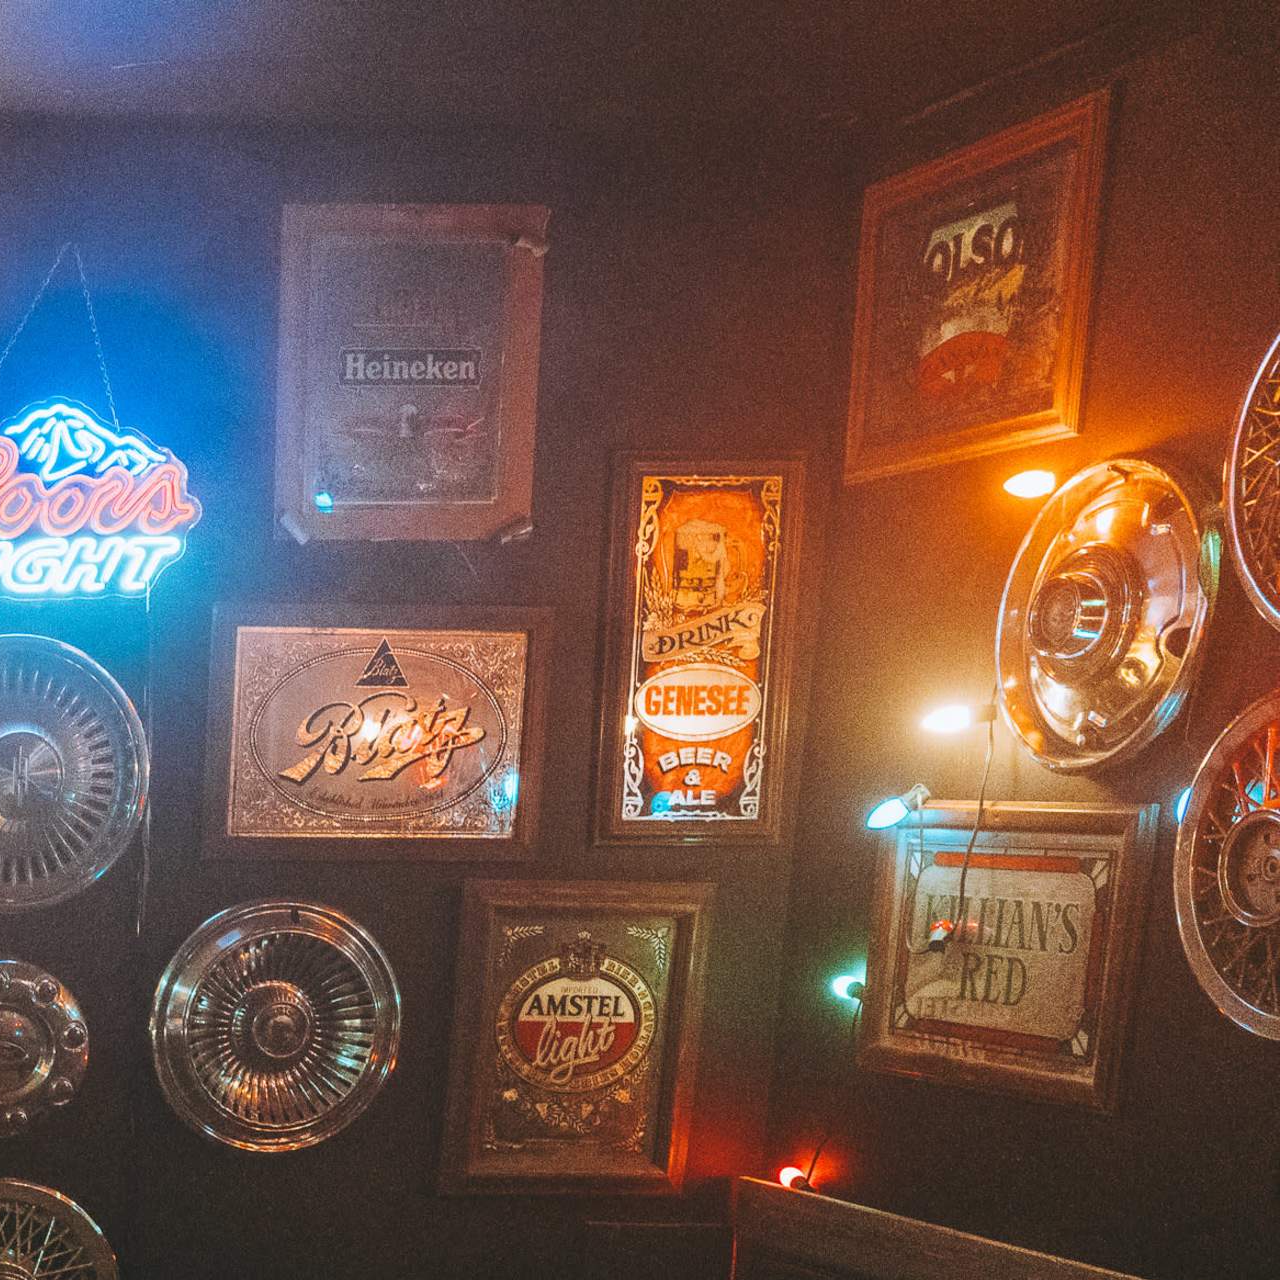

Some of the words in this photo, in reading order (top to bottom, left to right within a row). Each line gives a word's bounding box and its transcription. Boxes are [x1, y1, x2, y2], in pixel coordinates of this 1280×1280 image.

[926, 216, 1026, 283] OLSO
[343, 352, 477, 382] Heineken
[650, 610, 746, 656] DRINK
[645, 684, 751, 718] GENESEE
[278, 691, 487, 783] Blatz
[657, 747, 734, 774] BEER
[684, 769, 701, 787] &
[668, 789, 717, 807] ALE
[959, 952, 1029, 1006] RED
[526, 993, 627, 1019] AMSTEL
[532, 1010, 617, 1086] light
